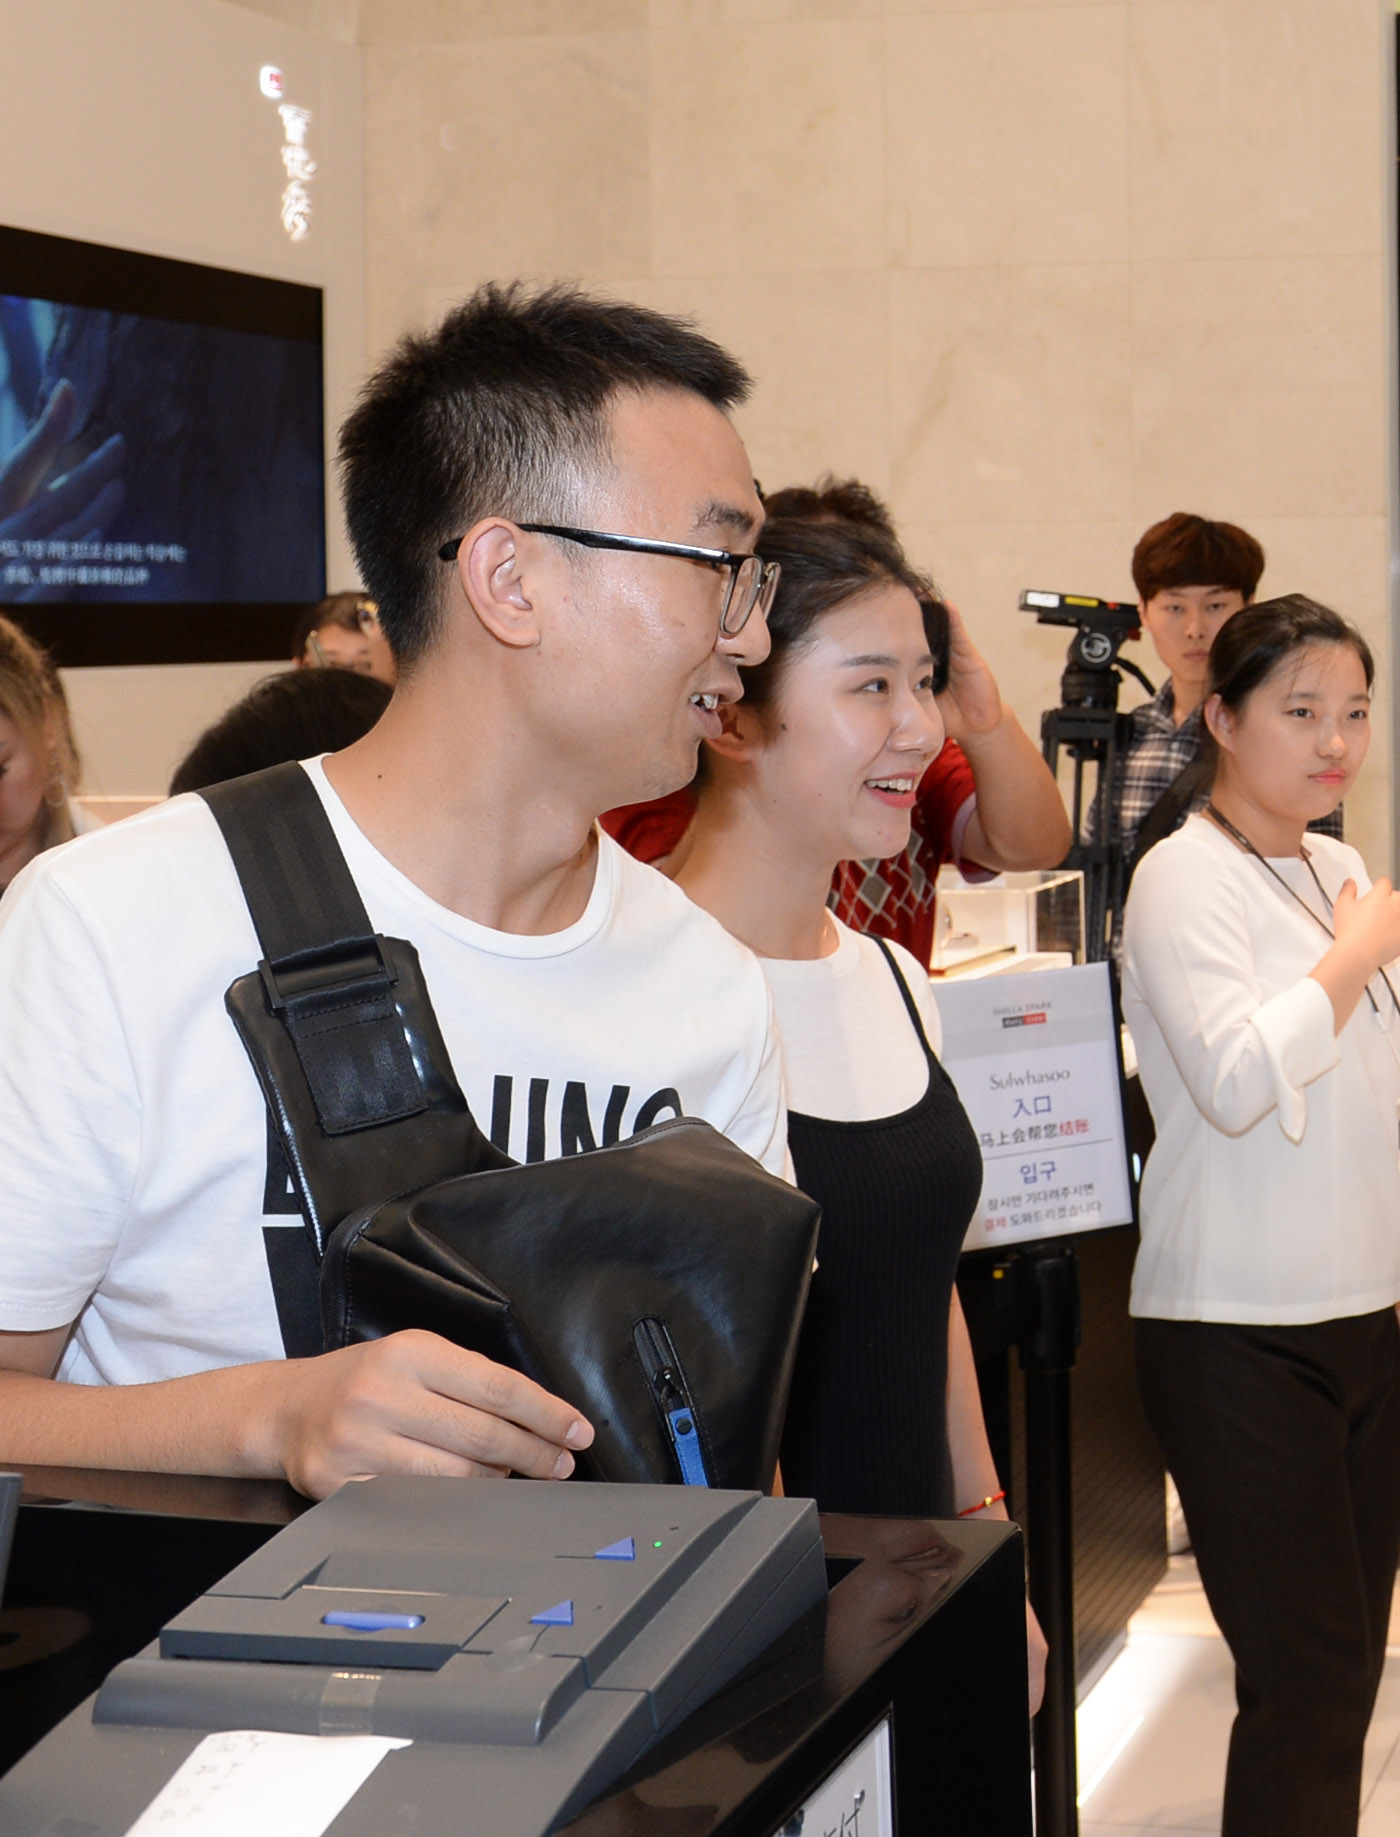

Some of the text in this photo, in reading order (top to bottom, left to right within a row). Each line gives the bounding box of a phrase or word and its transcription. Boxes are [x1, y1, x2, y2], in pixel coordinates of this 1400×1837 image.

[990, 1068, 1071, 1091] Sulwhasoo
[1012, 1096, 1053, 1119] 入口
[1020, 1161, 1056, 1184] 입구
